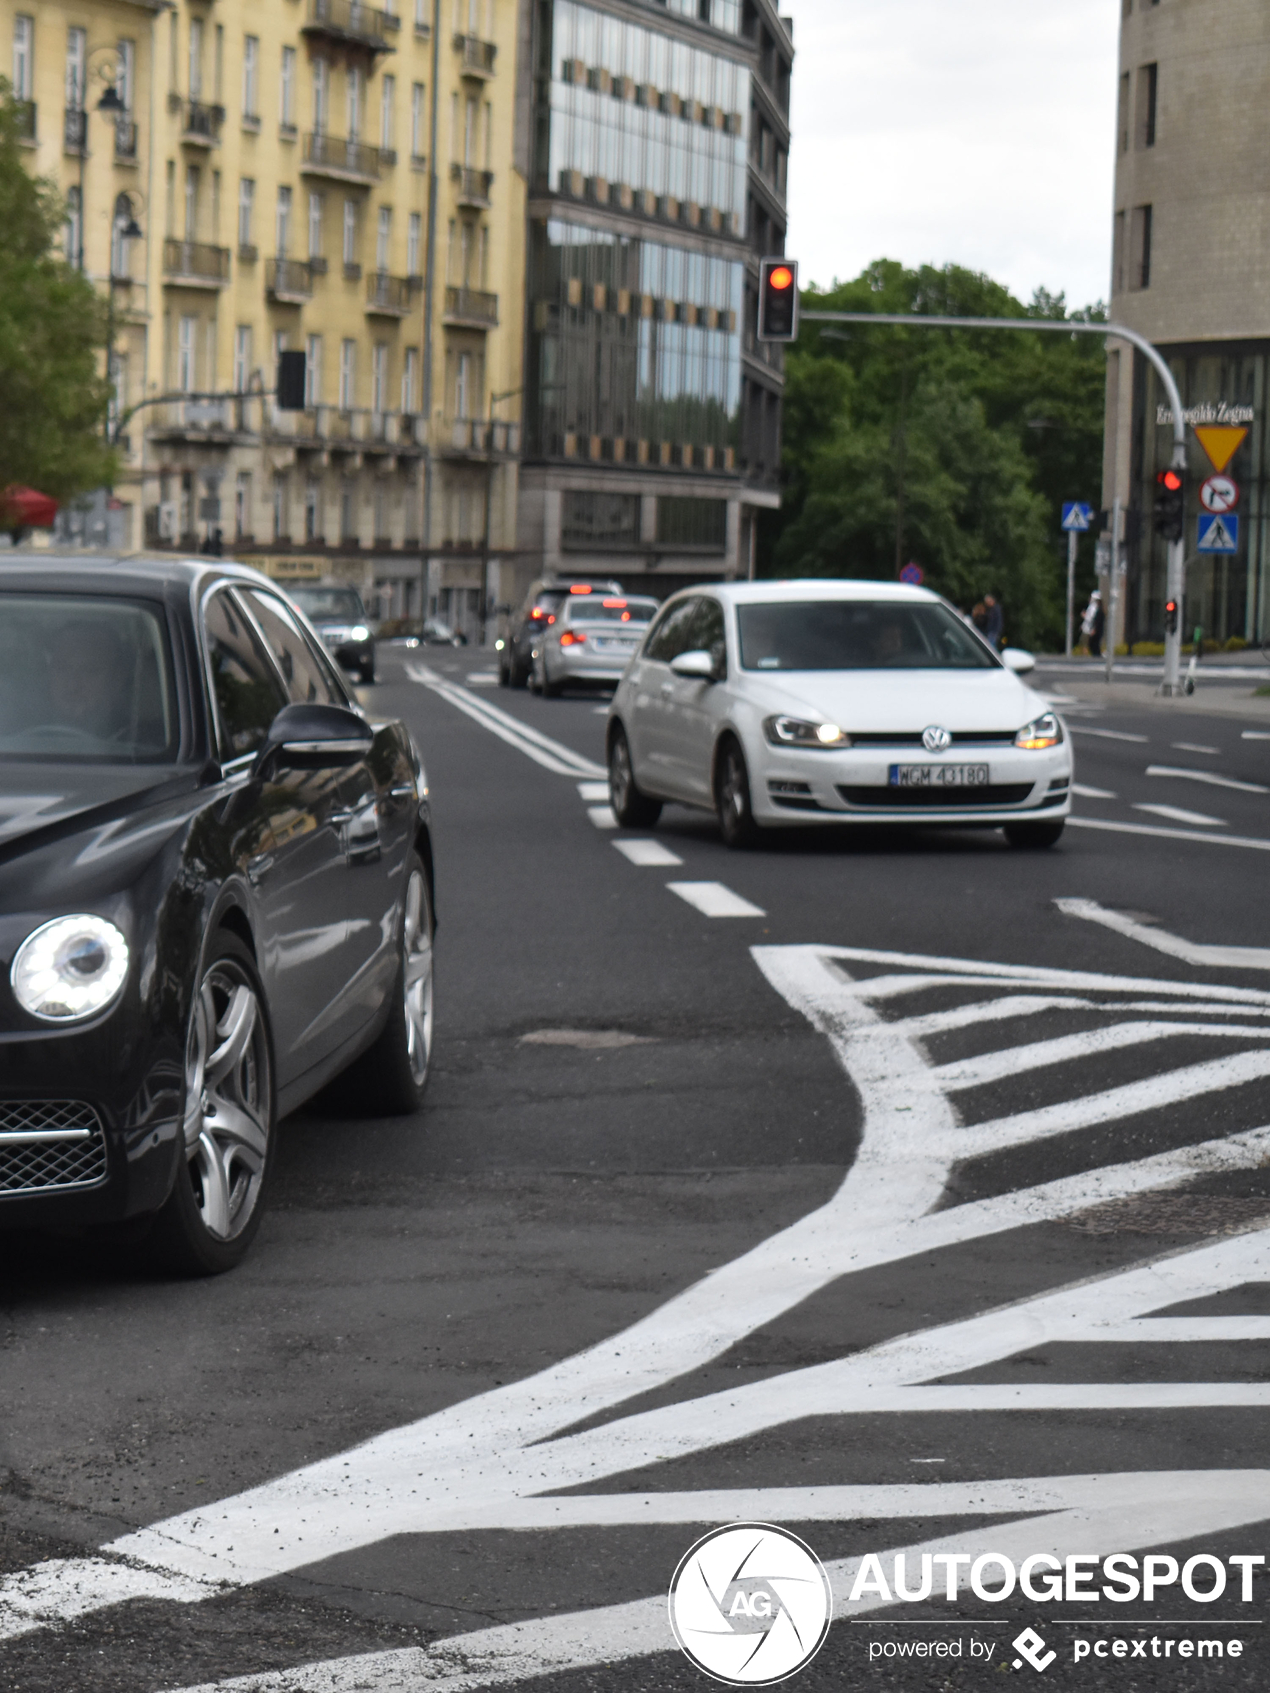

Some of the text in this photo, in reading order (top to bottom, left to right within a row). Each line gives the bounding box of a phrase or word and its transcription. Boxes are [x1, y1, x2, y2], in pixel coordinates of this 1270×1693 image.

[1217, 401, 1254, 427] Zegna
[898, 765, 987, 786] WGM 43180
